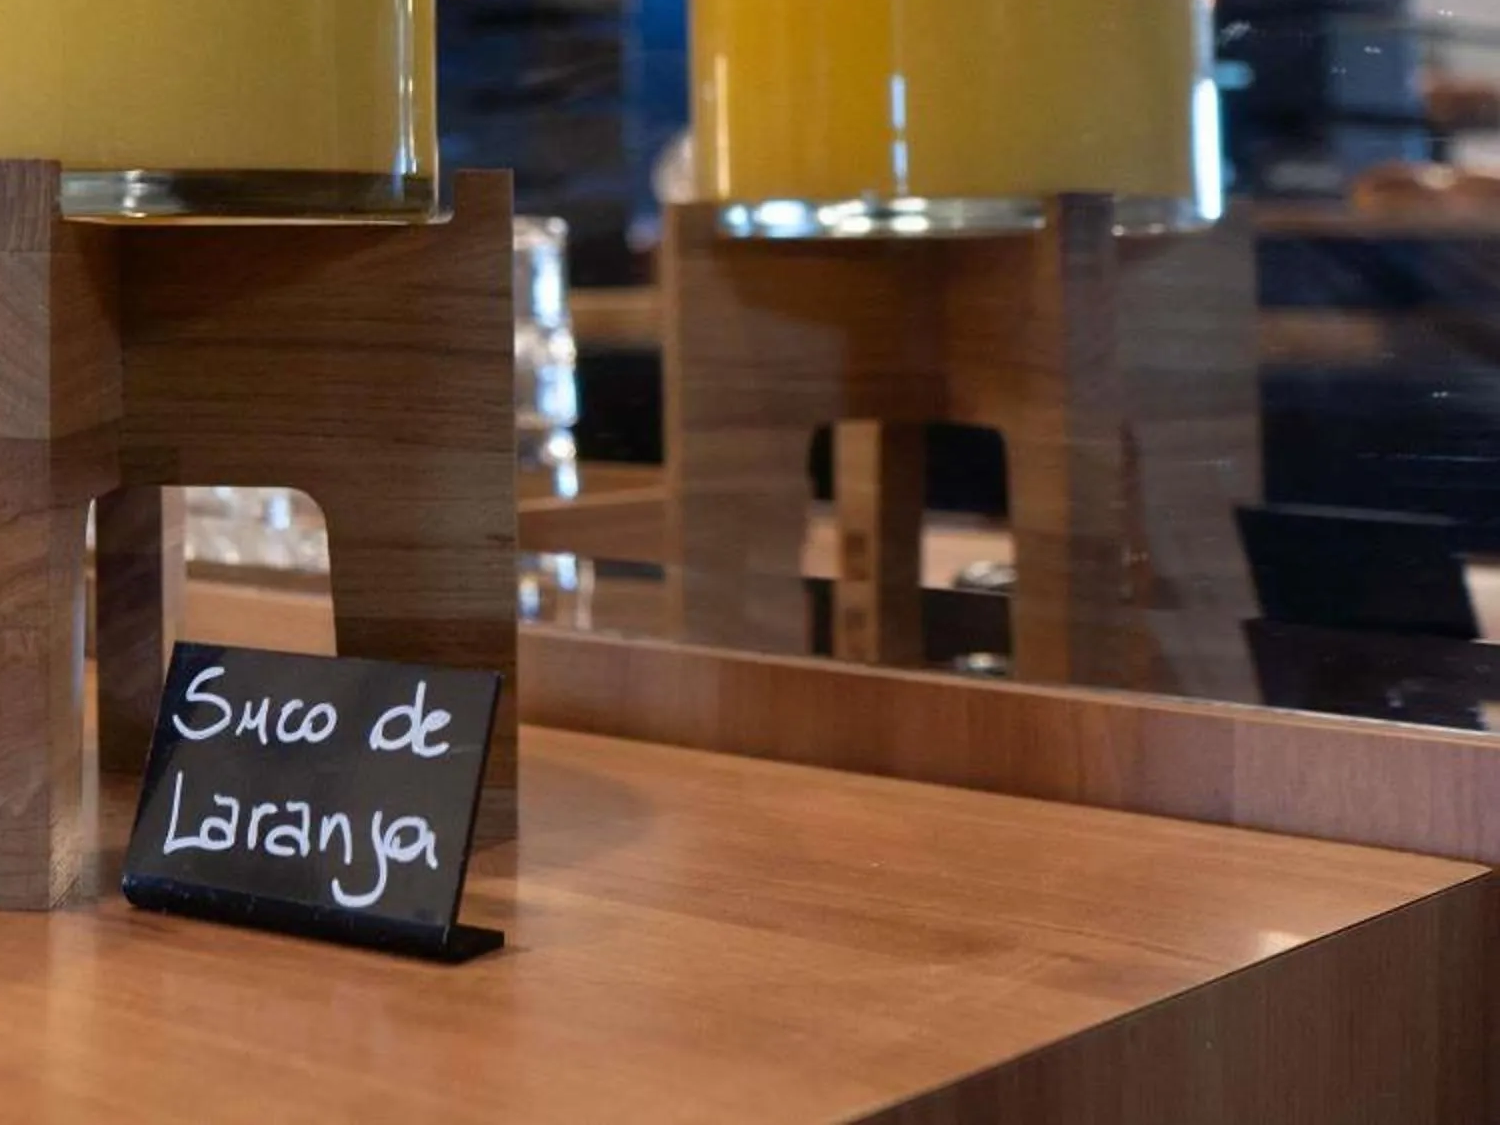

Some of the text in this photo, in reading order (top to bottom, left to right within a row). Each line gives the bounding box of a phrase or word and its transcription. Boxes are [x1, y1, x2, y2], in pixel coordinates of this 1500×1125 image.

[172, 666, 452, 758] Suco de
[163, 771, 439, 908] Laranja
